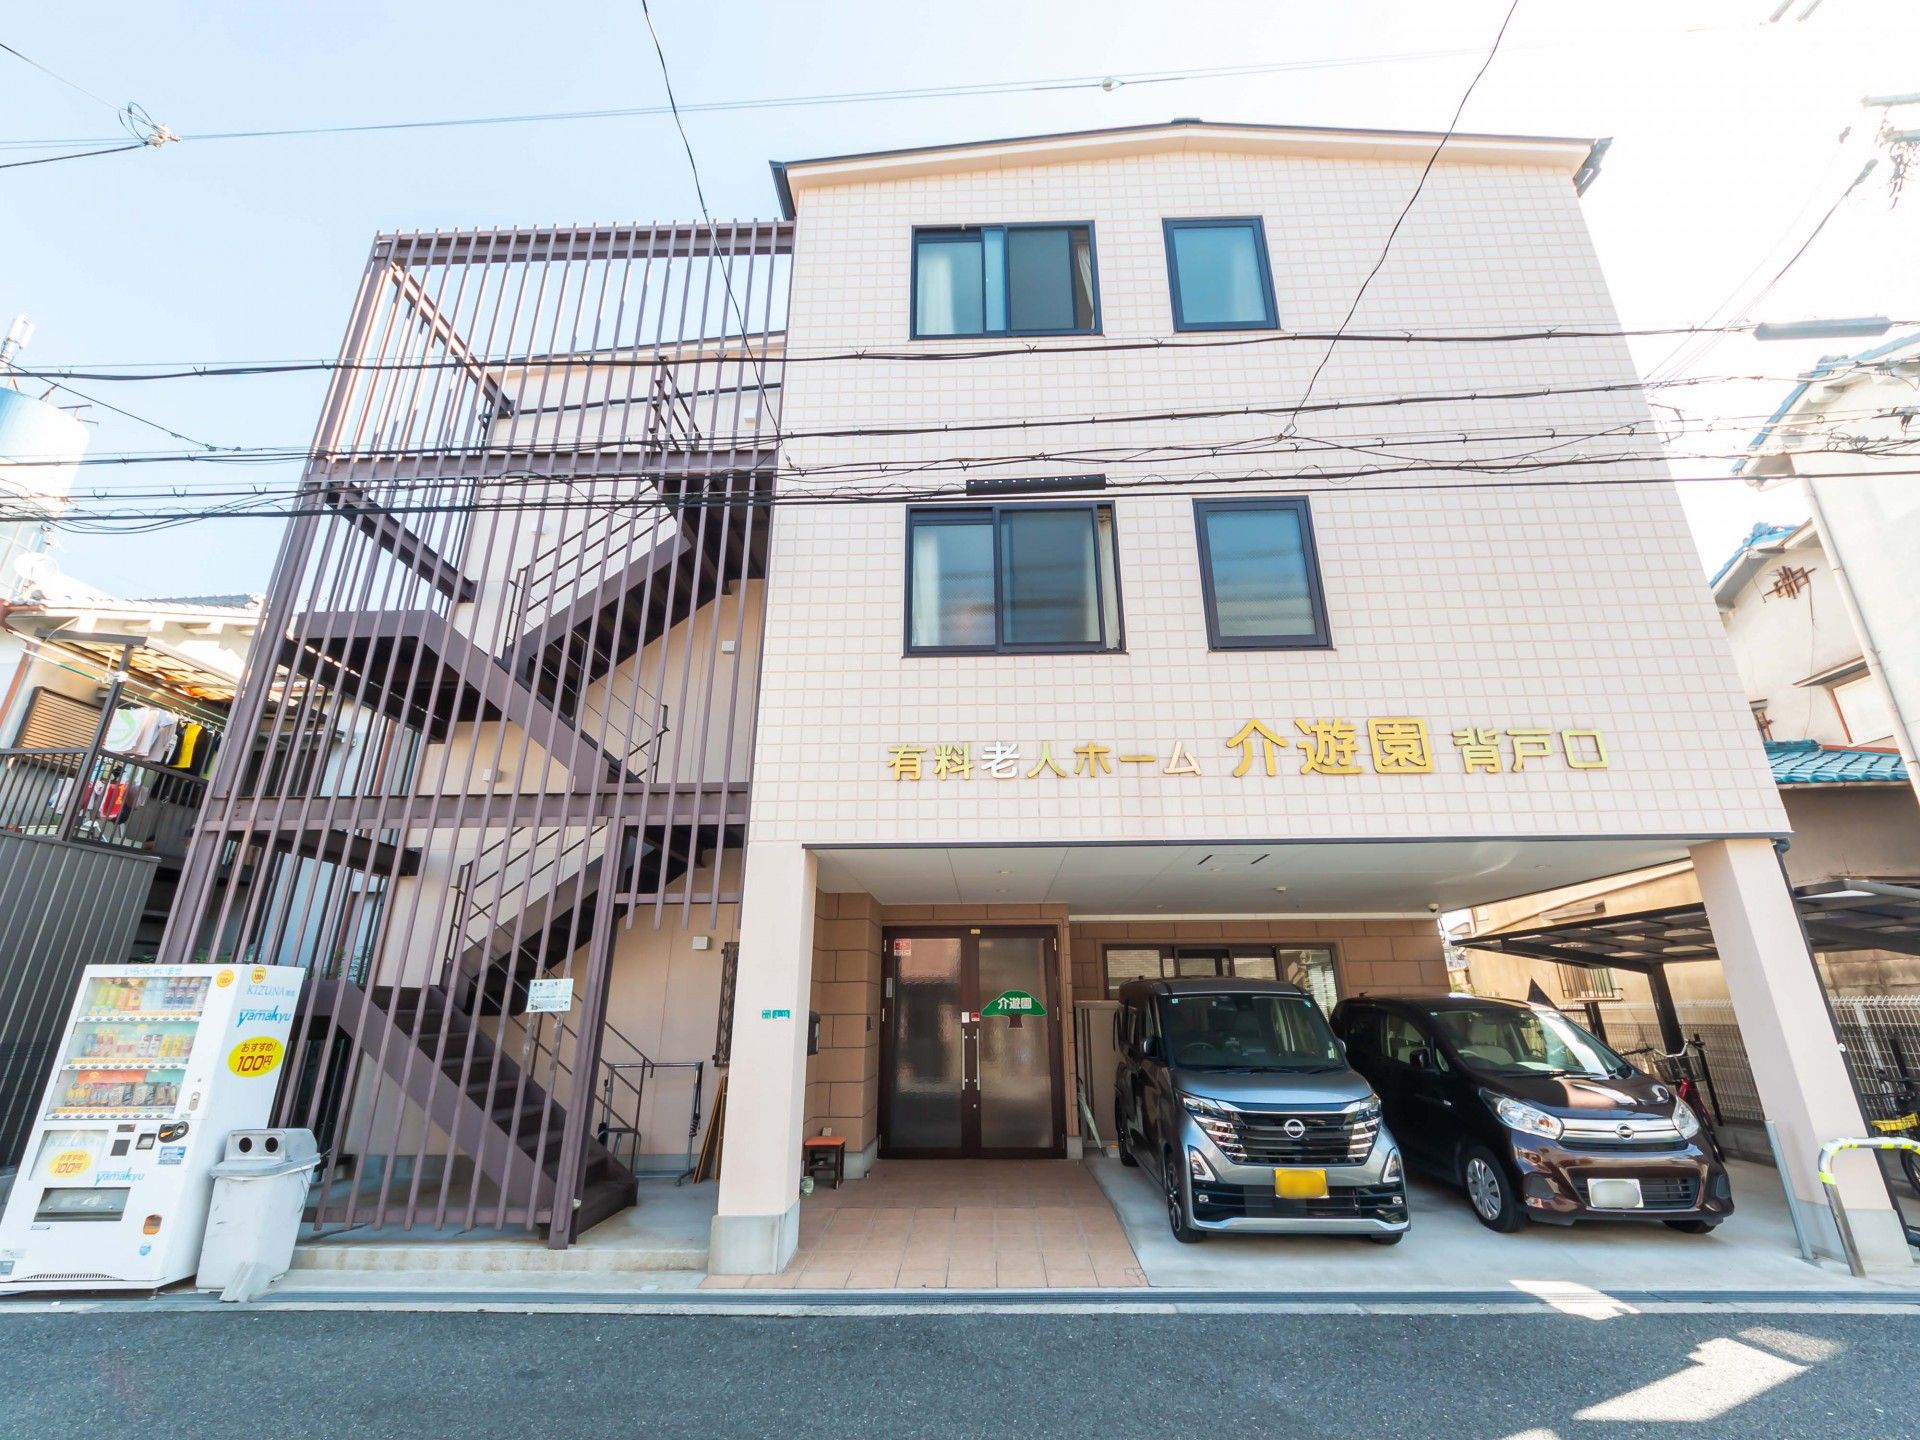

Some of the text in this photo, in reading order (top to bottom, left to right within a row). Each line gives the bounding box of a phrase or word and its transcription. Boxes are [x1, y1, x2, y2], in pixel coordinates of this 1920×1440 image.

[888, 717, 1608, 781] 有料老人ホーム 介遊園 背戸口
[997, 997, 1032, 1010] 介遊園
[236, 1005, 292, 1028] yamakyu
[237, 1055, 273, 1072] 100円
[94, 1167, 145, 1186] yamakyu
